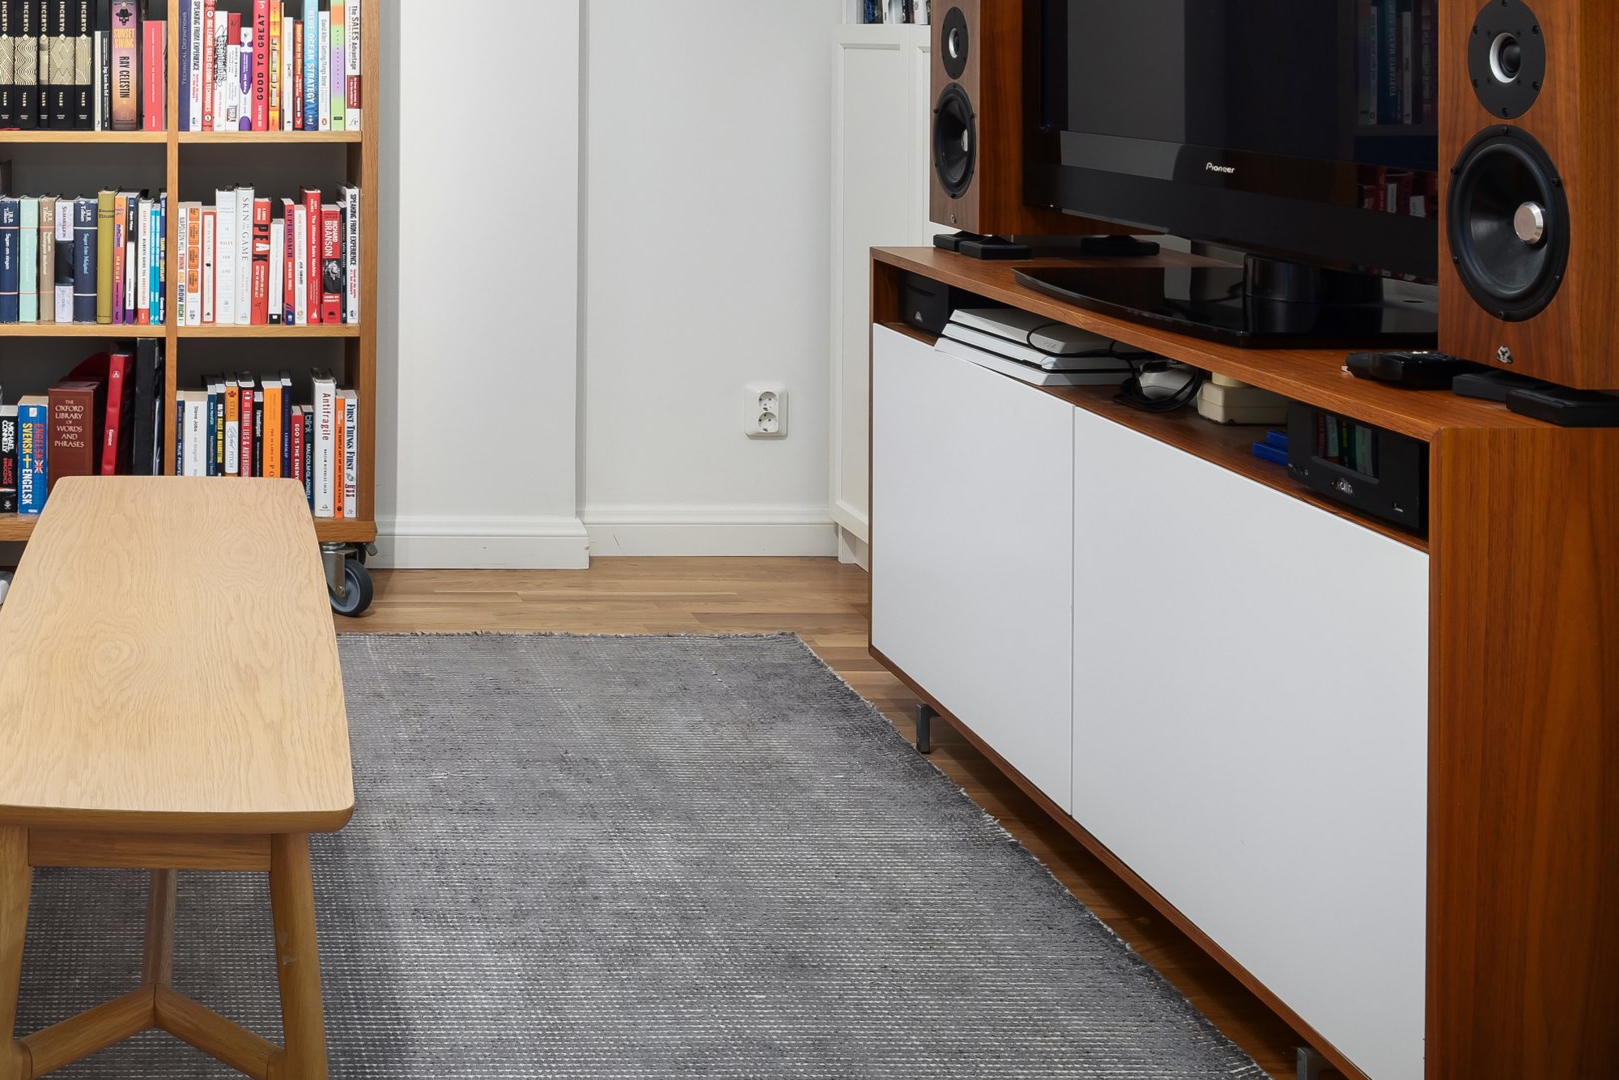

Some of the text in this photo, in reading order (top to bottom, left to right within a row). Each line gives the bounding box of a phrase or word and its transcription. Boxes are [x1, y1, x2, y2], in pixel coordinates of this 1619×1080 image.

[114, 28, 134, 38] SUNSET
[115, 39, 134, 48] SWING
[258, 54, 264, 66] TO
[307, 11, 315, 103] BLUE OCEAN STRATEGY
[120, 56, 130, 98] RAY CELESTIN
[1205, 162, 1235, 174] Pioneer
[253, 224, 269, 262] PEAK
[321, 393, 331, 440] Antifragile
[22, 423, 32, 504] SVENSK ENGELSK
[347, 451, 355, 470] FIRST
